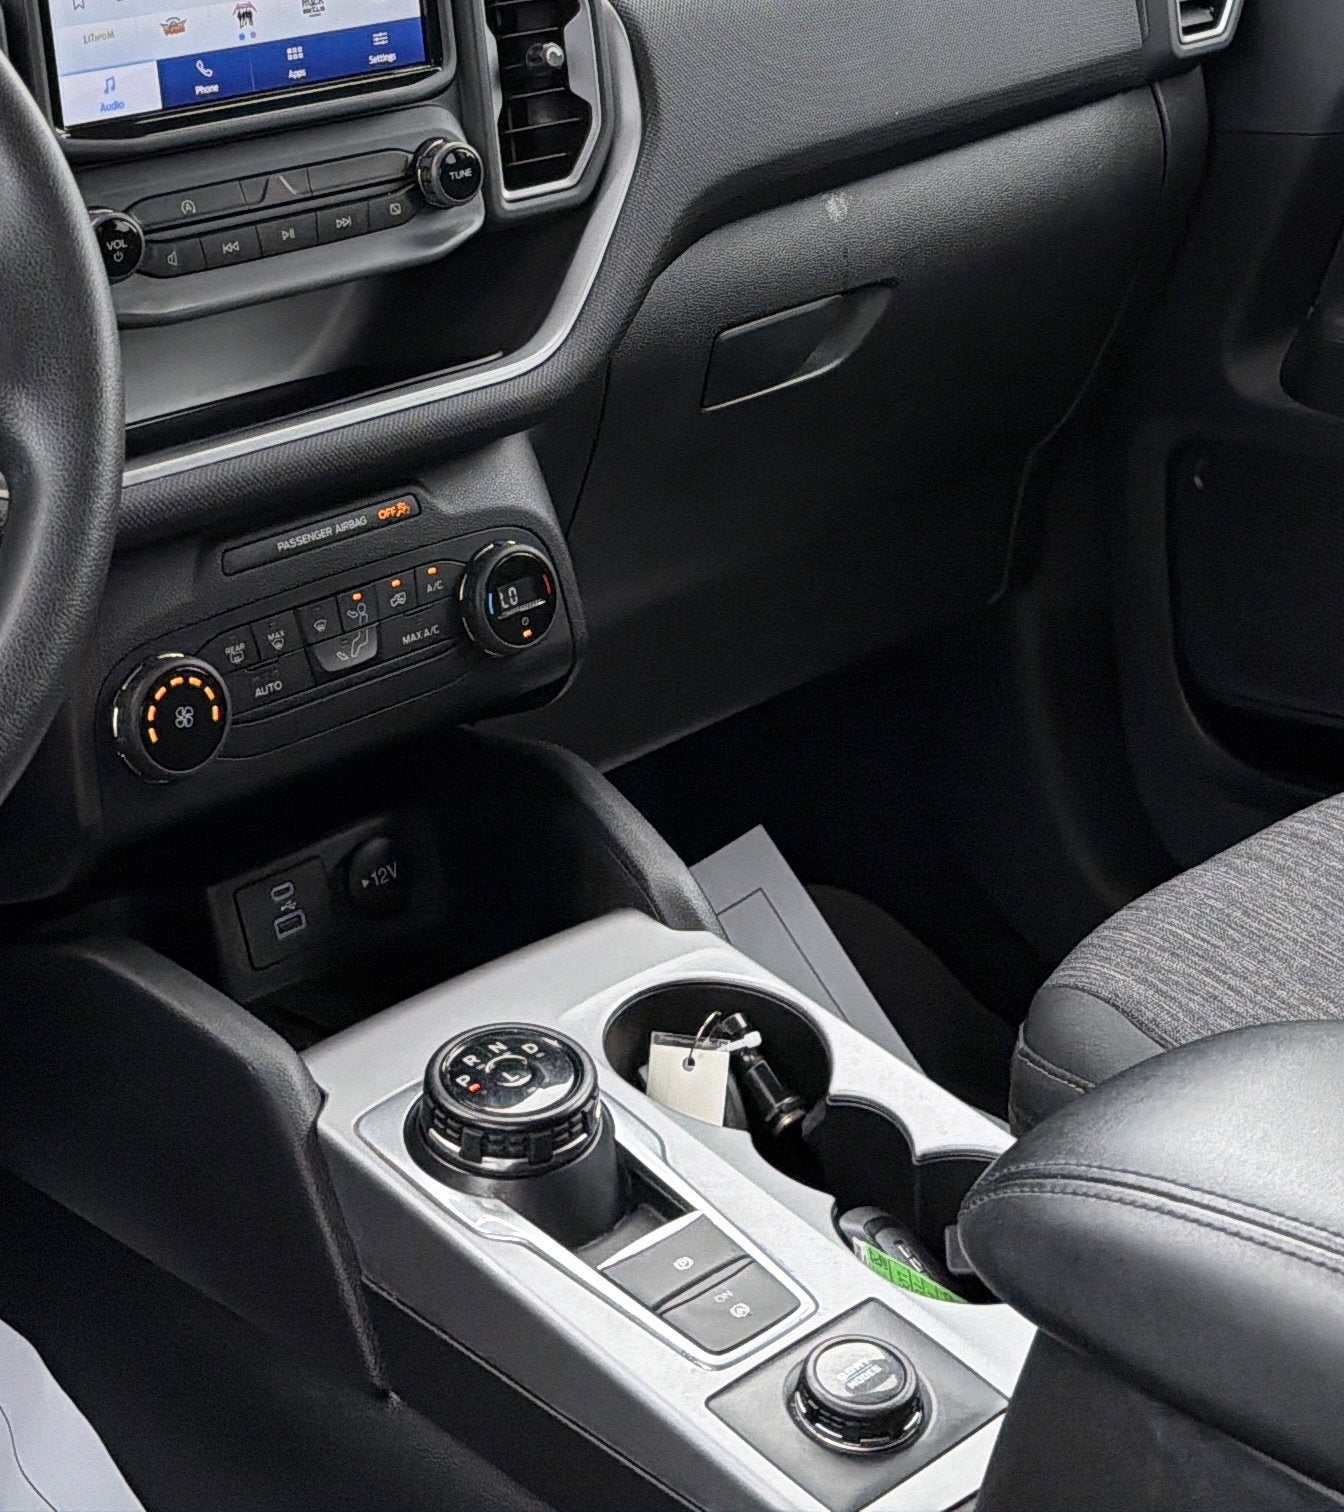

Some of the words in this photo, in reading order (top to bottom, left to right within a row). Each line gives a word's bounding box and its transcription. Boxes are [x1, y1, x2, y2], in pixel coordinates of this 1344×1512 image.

[368, 52, 397, 66] Settings
[288, 68, 307, 80] Apps
[195, 84, 219, 96] Phone
[100, 100, 125, 113] Audio
[448, 166, 473, 181] TUNE
[106, 238, 128, 252] VOL
[276, 526, 334, 552] PASSENGER
[335, 515, 368, 534] AIRBAG
[378, 506, 398, 520] OFF
[426, 579, 444, 593] A/C
[499, 586, 519, 608] LO
[267, 629, 286, 644] MAX
[402, 628, 422, 646] MAX
[422, 624, 441, 639] A/C
[225, 642, 246, 658] REAR
[254, 680, 284, 699] AUTO
[370, 862, 398, 887] 12V
[488, 1041, 509, 1054] N
[521, 1043, 539, 1054] D
[462, 1054, 481, 1067] R
[455, 1074, 471, 1088] P
[502, 1071, 520, 1082] L
